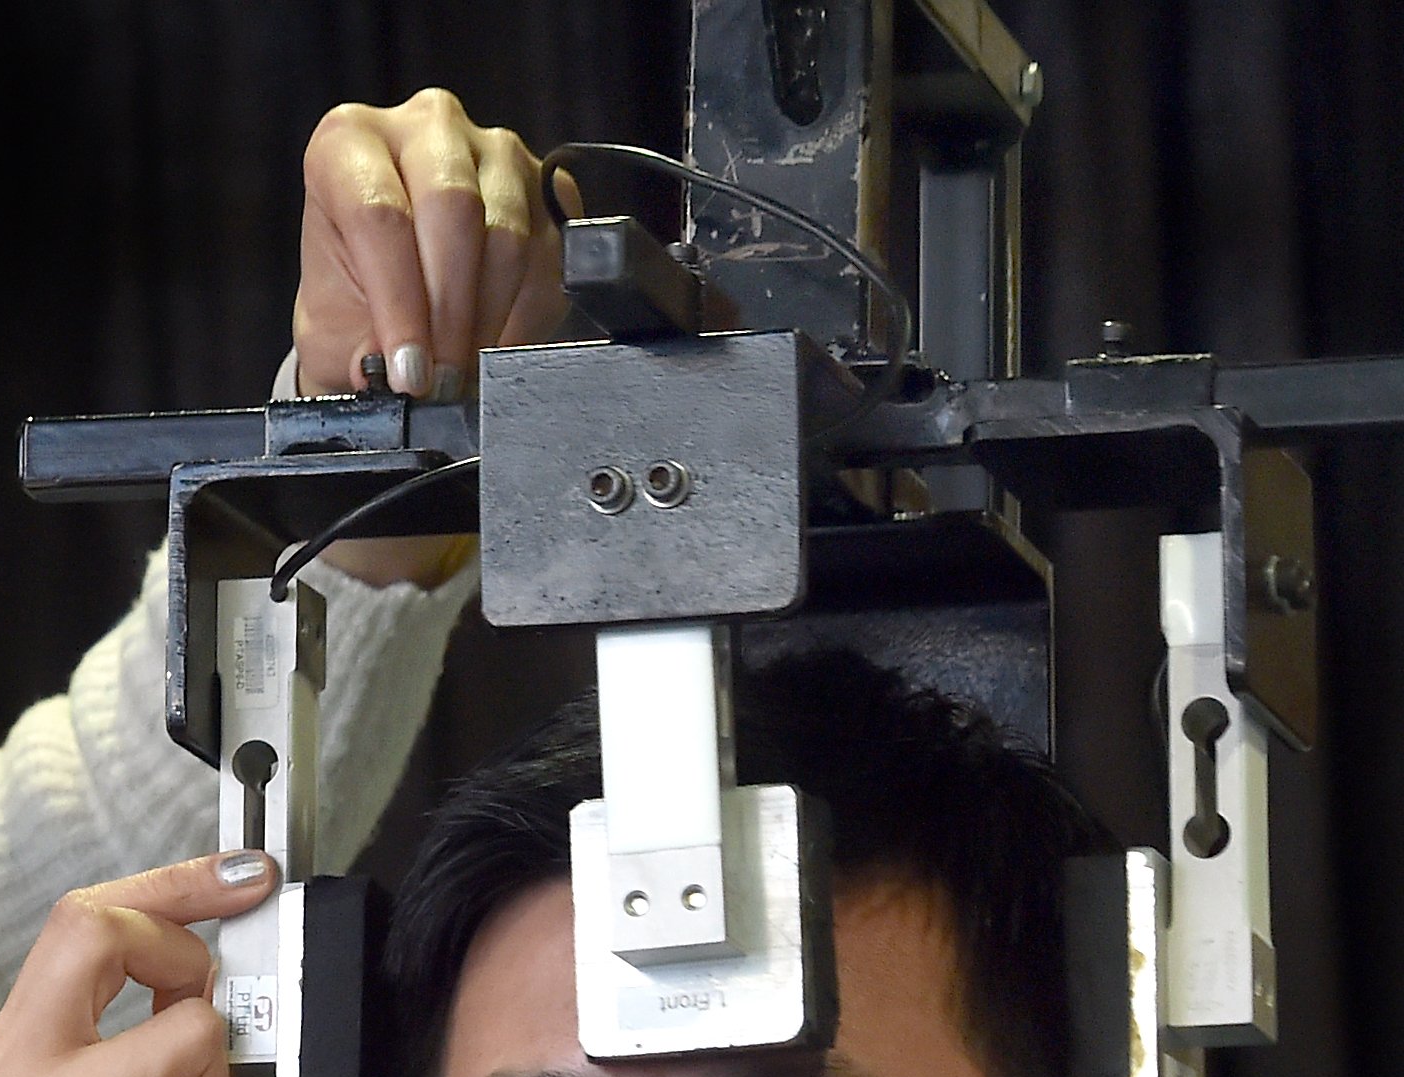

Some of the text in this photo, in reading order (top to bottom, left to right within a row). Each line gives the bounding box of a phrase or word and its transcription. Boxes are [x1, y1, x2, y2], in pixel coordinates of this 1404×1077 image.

[236, 992, 251, 1036] PT Ltd
[659, 992, 710, 1013] Front
